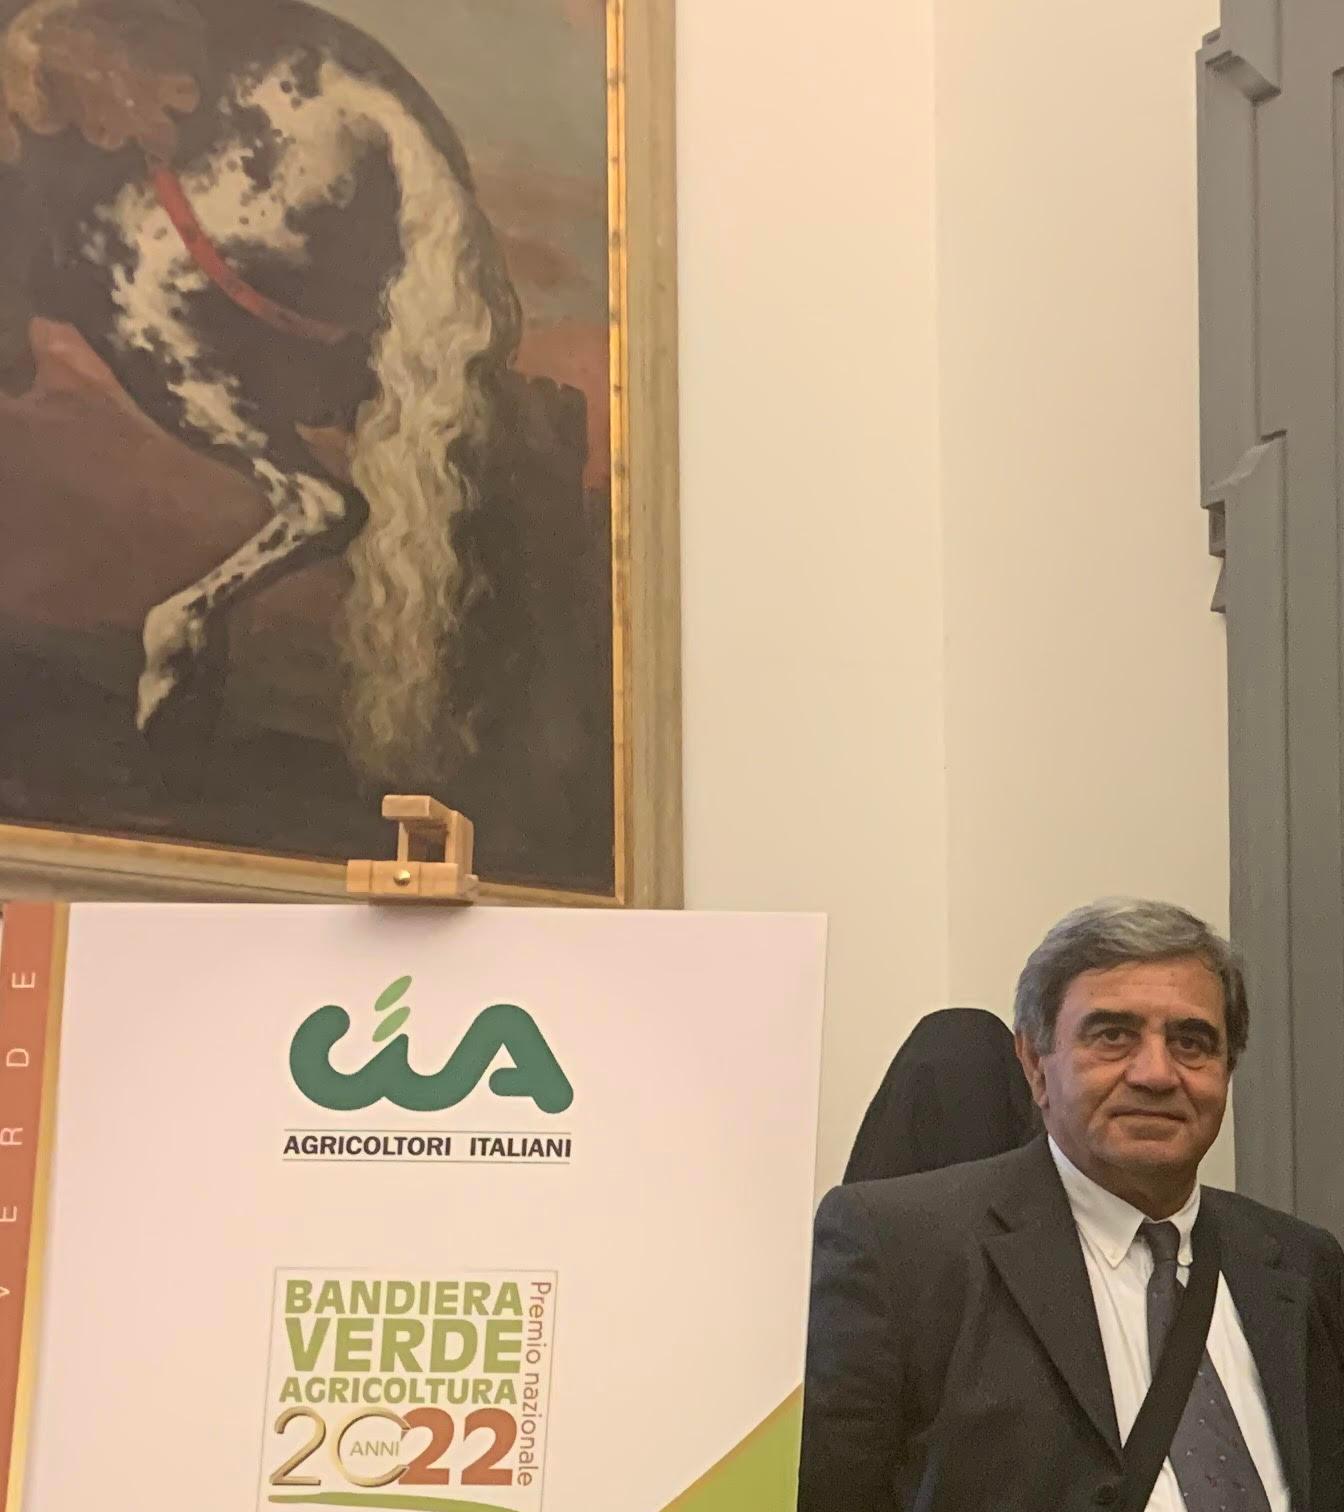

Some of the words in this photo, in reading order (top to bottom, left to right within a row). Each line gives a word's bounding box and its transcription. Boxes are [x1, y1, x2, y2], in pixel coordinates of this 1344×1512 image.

[283, 1135, 451, 1156] AGRICOLTORI
[469, 1137, 571, 1158] ITALIANI
[284, 1279, 523, 1316] BANDIERA
[525, 1281, 552, 1365] Premio
[285, 1317, 523, 1374] VERDE
[278, 1376, 518, 1404] AGRICOLTURA
[517, 1372, 543, 1487] nazionale
[350, 1441, 400, 1457] ANNI
